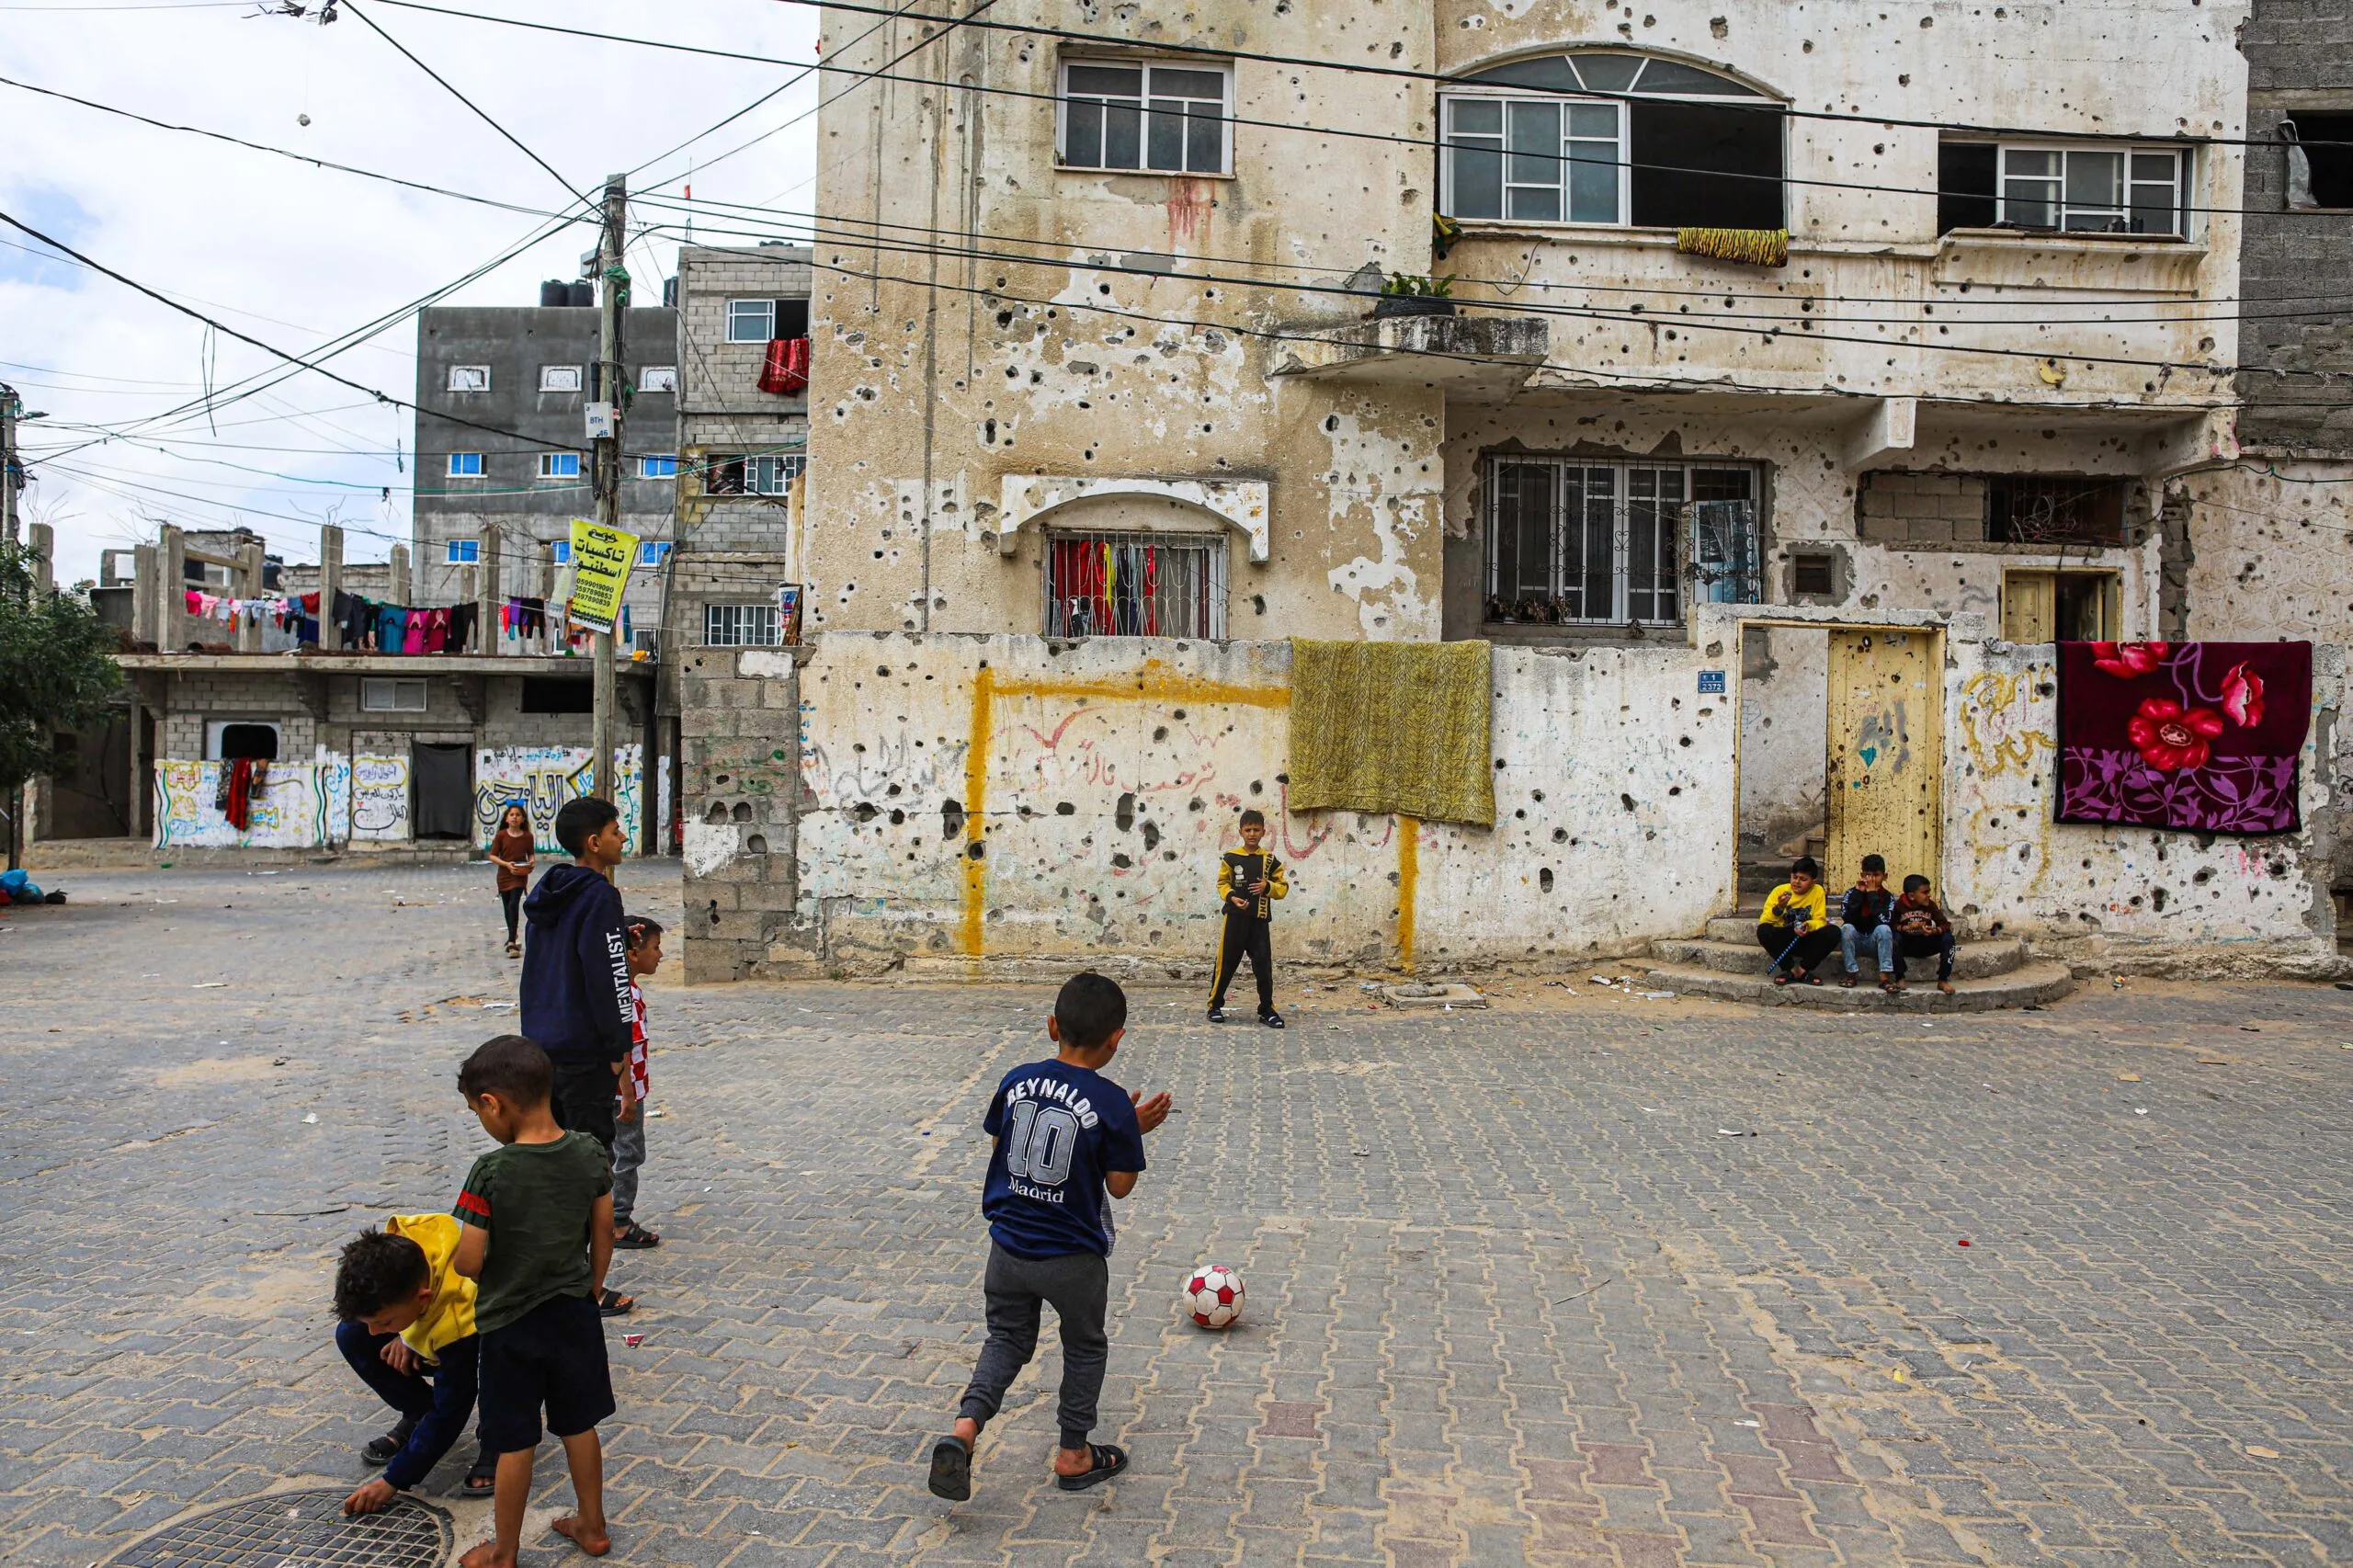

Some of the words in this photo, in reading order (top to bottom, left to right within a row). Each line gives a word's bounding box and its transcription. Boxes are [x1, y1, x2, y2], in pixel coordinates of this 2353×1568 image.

[574, 539, 625, 563] تاكسيات
[576, 555, 622, 580] اسطنبو
[1006, 1076, 1098, 1130] REYNALDO
[1006, 1099, 1079, 1187] 10
[1007, 1176, 1064, 1204] Madrid
